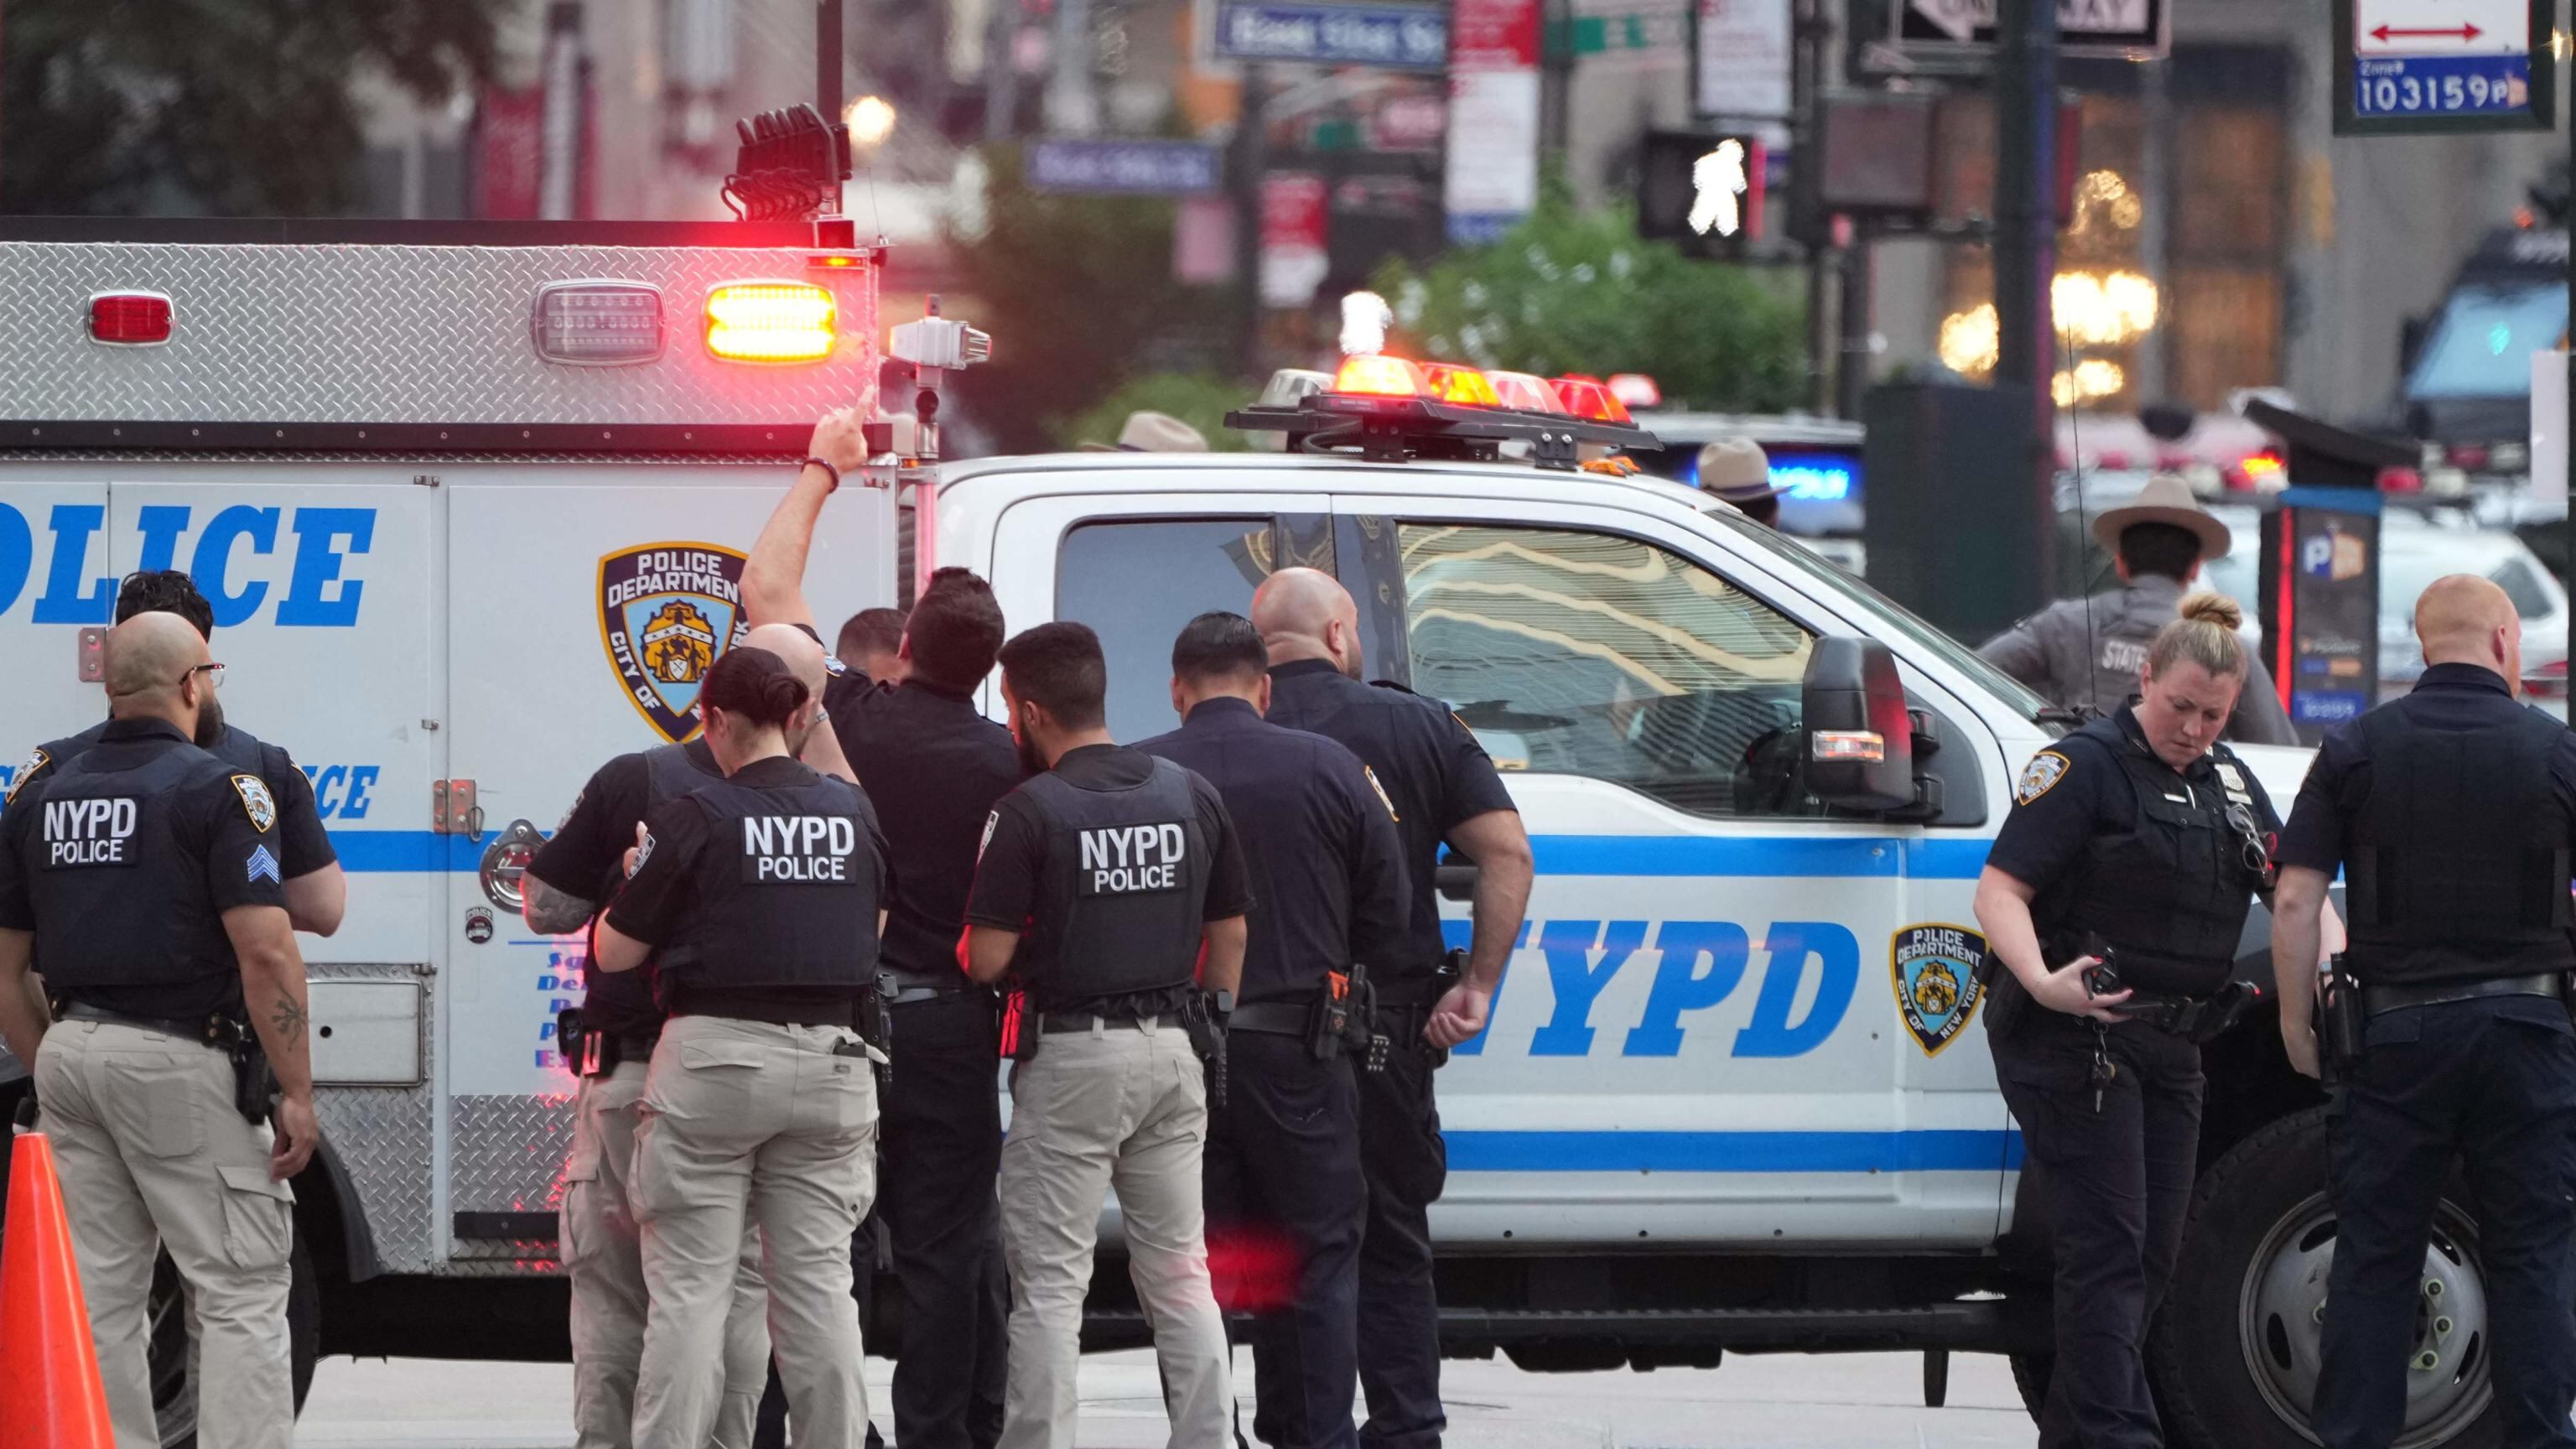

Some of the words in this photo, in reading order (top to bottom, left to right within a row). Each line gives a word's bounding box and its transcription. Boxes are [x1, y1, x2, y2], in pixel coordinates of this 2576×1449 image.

[638, 551, 722, 577] POLICE
[608, 571, 745, 609] DEPARTMEN
[610, 631, 641, 679] CITY
[635, 684, 661, 709] OF
[44, 797, 136, 841] NYPD
[744, 816, 854, 856] NYPD
[1080, 823, 1185, 870] NYPD
[51, 839, 123, 865] POLICE
[758, 856, 845, 880] POLICE
[1094, 865, 1176, 893] POLICE
[1913, 928, 1965, 947] POLICE
[1897, 941, 1982, 968] DEPARTMENT
[1898, 979, 1913, 1010] CITY
[1908, 1015, 1926, 1031] OF
[1939, 1012, 1964, 1040] NEW
